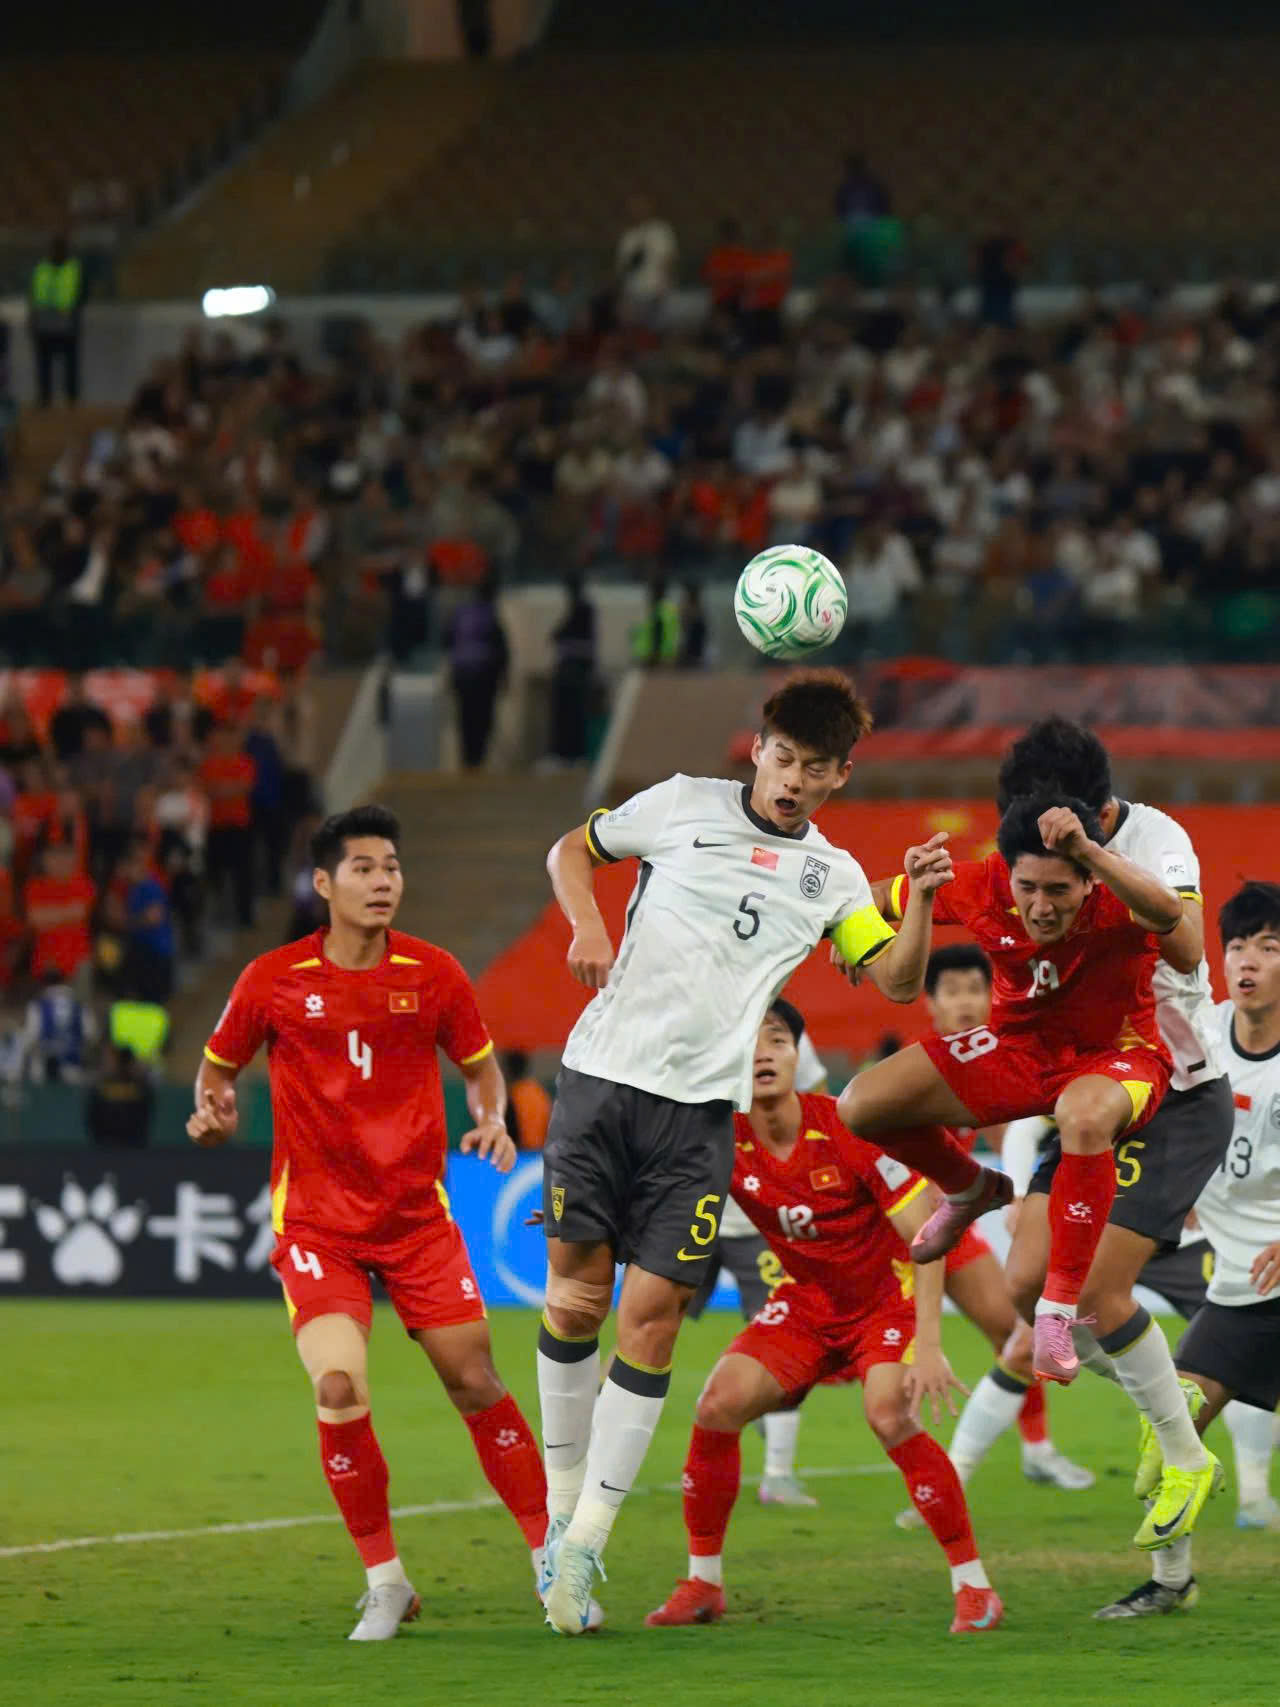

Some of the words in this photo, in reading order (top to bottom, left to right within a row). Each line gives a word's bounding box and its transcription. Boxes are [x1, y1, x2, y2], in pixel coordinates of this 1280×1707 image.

[732, 891, 767, 941] 5
[1026, 958, 1060, 998] 19
[347, 1029, 373, 1080] 4
[941, 1024, 999, 1063] 19
[690, 1193, 720, 1246] 5
[777, 1203, 819, 1242] 12
[289, 1243, 324, 1280] 4
